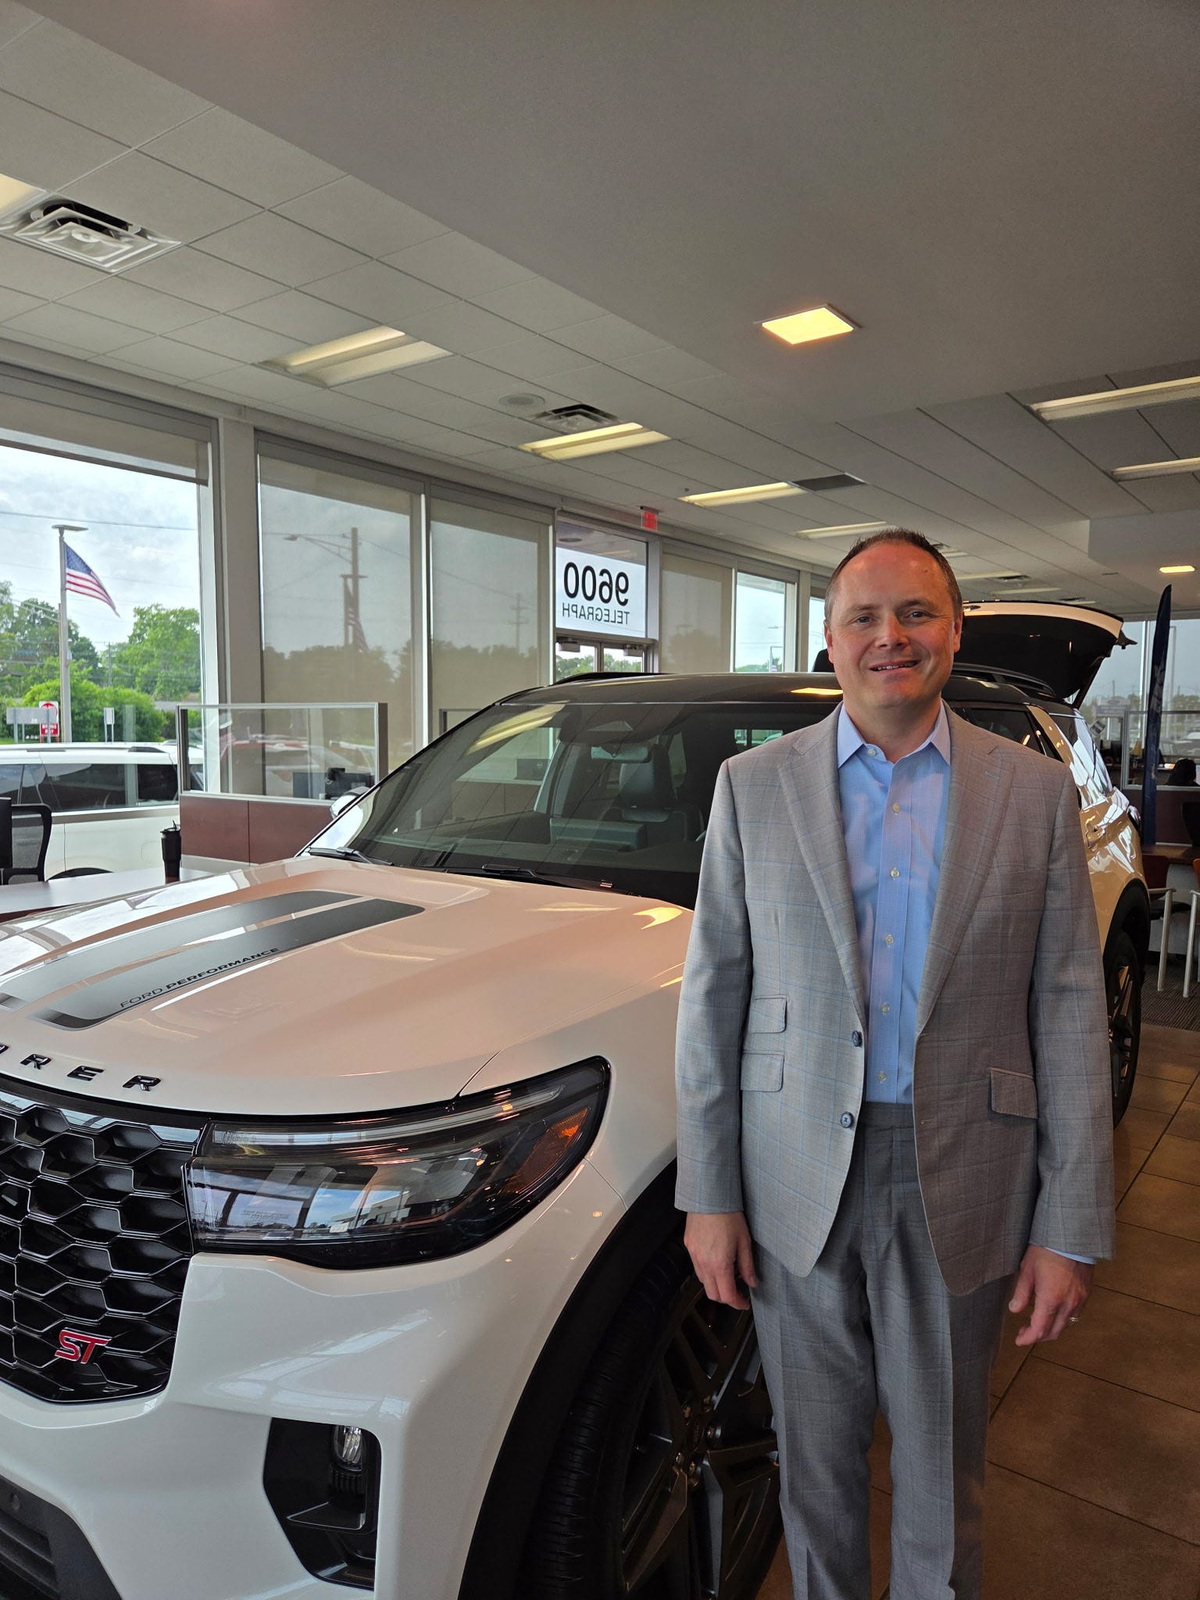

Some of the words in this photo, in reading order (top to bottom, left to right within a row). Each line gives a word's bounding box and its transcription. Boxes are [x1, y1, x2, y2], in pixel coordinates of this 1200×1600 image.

[120, 987, 164, 1008] FORD
[165, 947, 280, 989] PERFORMANCE
[54, 1328, 112, 1365] ST
